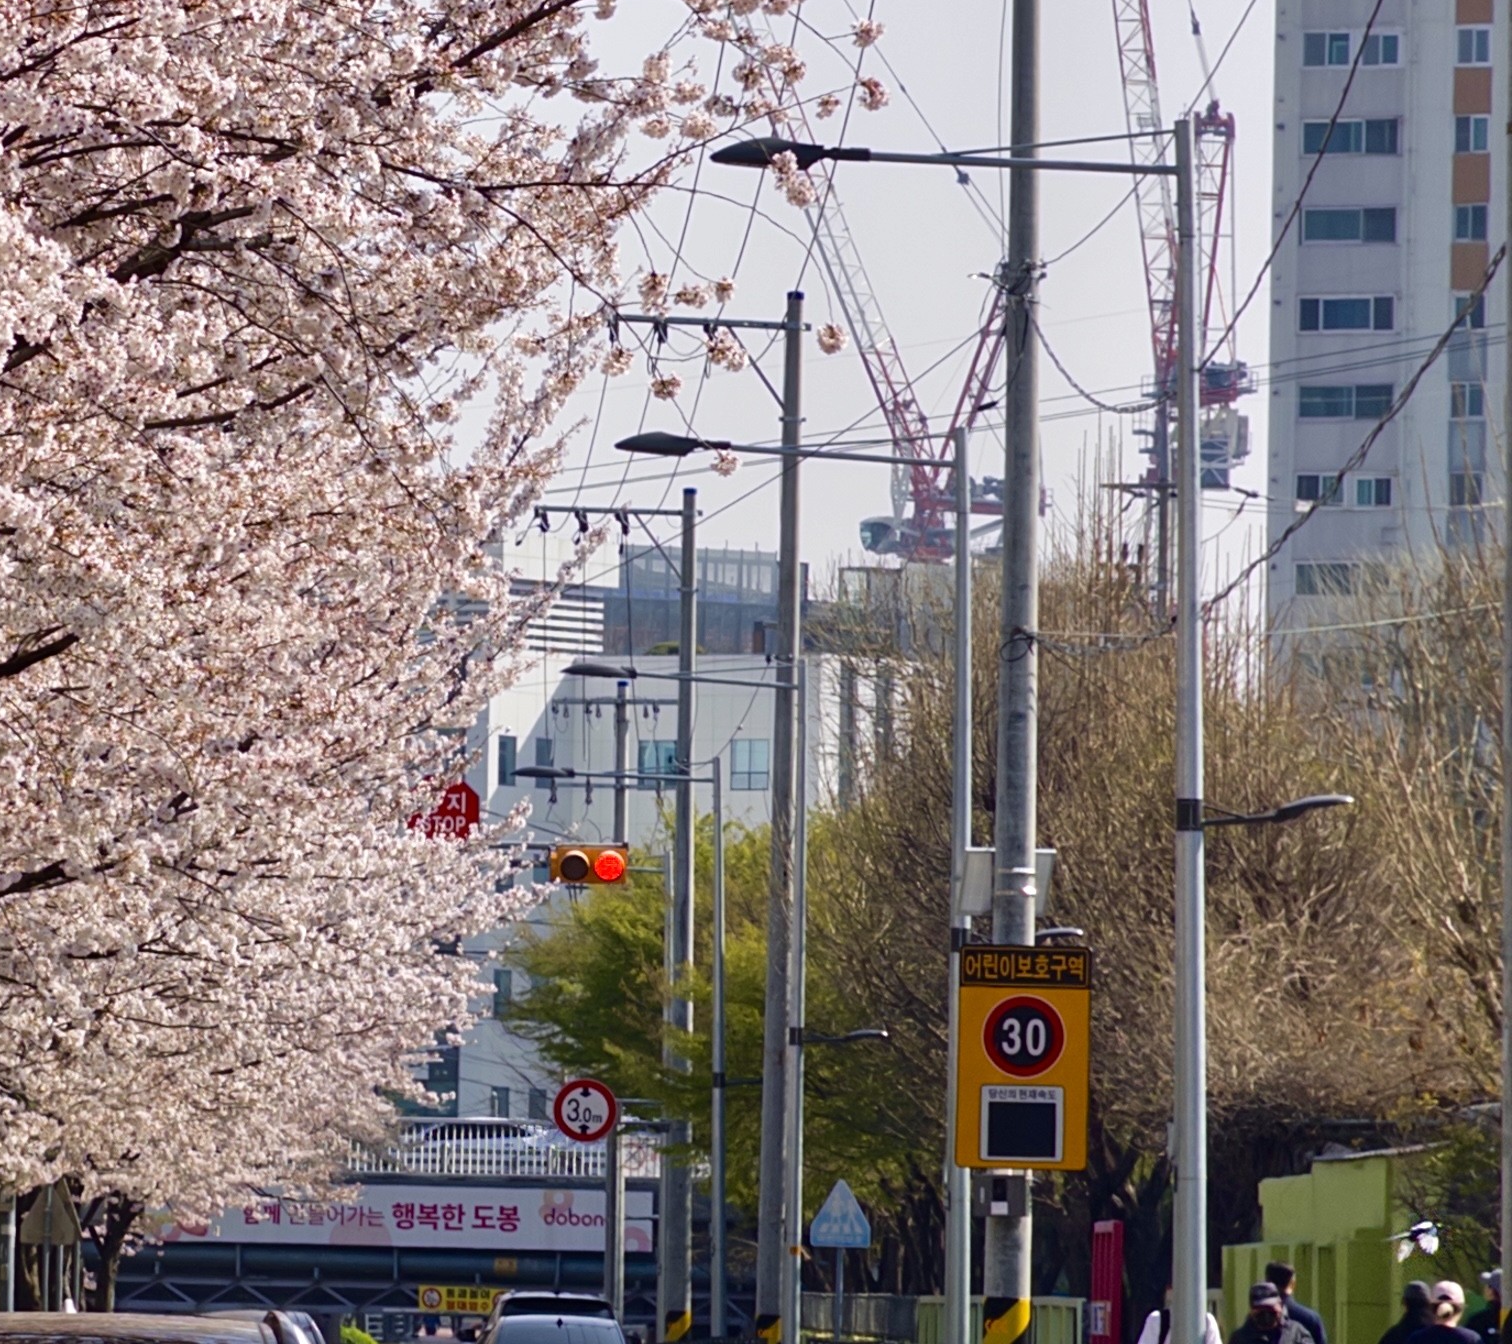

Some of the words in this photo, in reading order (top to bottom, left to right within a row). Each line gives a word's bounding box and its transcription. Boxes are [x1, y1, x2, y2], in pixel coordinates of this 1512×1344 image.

[423, 815, 466, 833] STOP
[965, 954, 1084, 981] 어린이보호구역
[1002, 1018, 1046, 1056] 30
[567, 1098, 602, 1123] 3.0m
[392, 1203, 465, 1231] 행복한
[471, 1205, 520, 1232] 도봉
[544, 1208, 606, 1228] dobon
